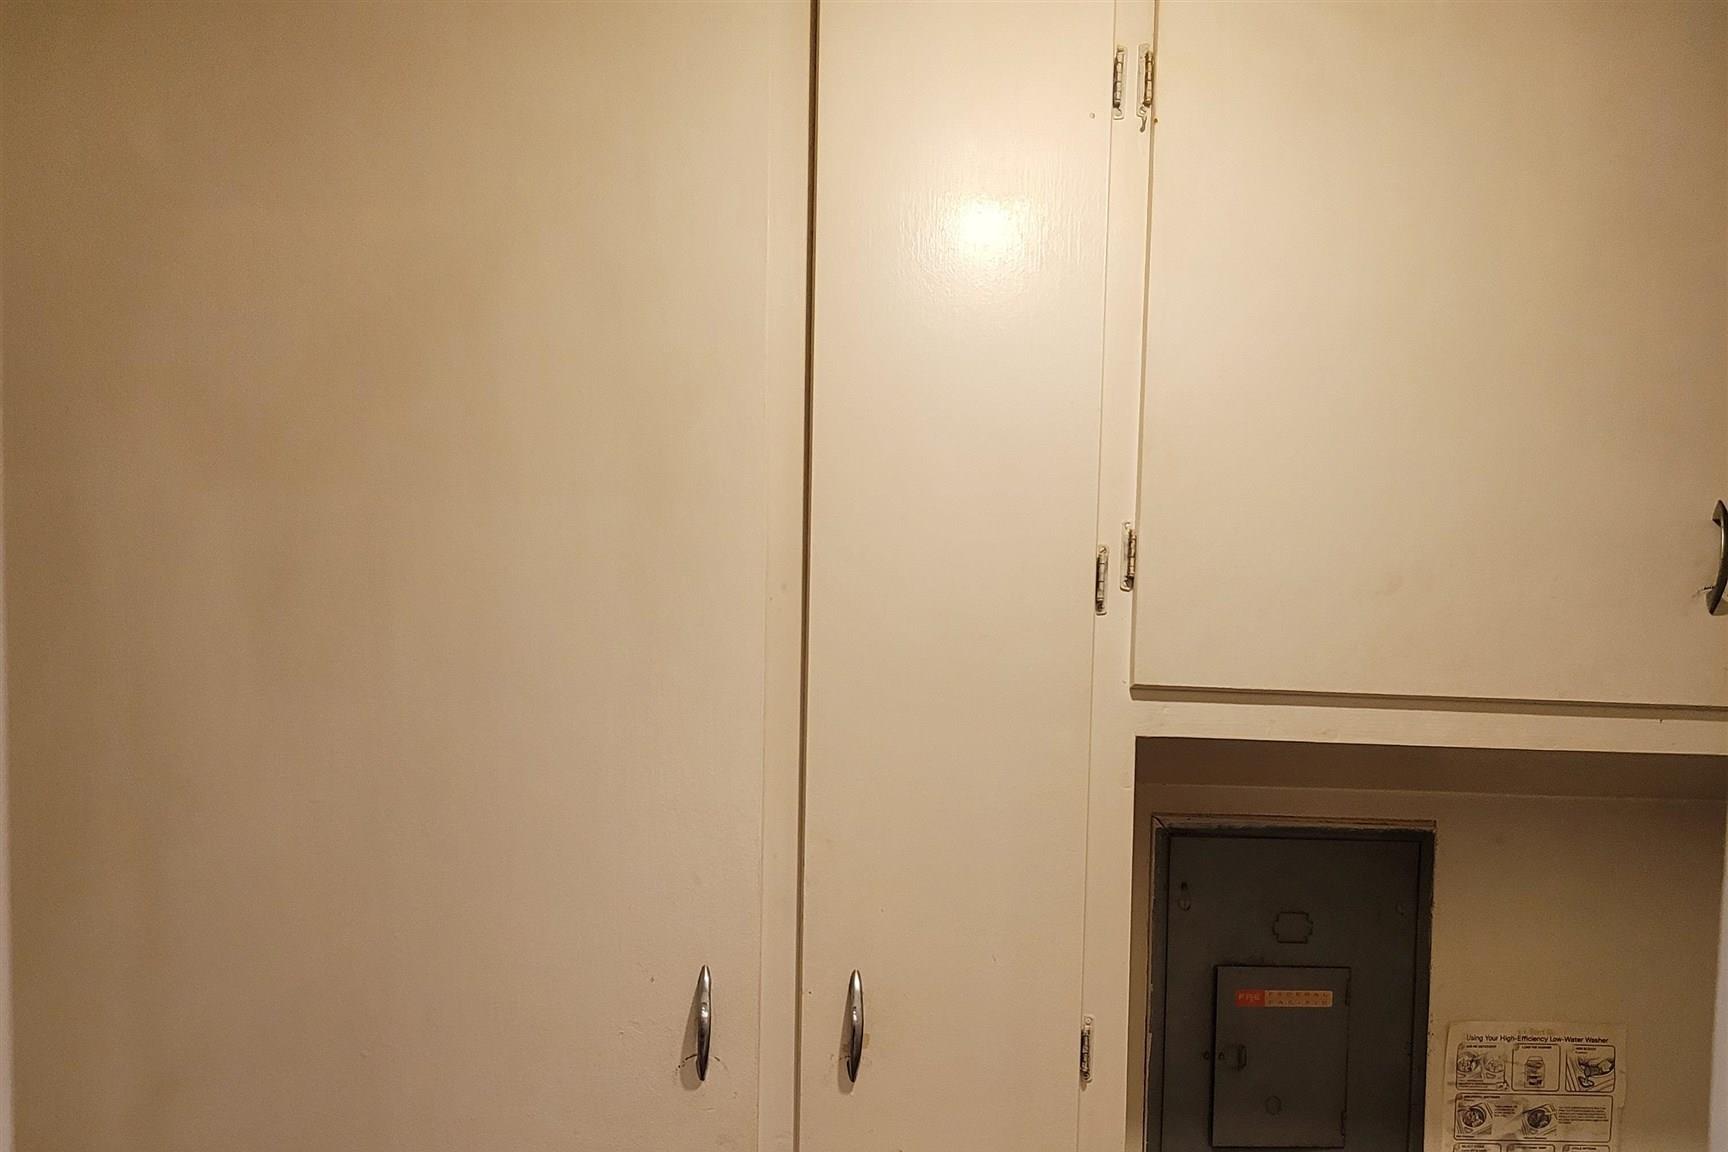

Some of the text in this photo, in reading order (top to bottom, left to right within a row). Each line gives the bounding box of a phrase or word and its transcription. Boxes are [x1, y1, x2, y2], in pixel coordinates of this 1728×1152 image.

[1466, 1034, 1484, 1042] Using
[1500, 1034, 1549, 1043] High-Efficiency
[1549, 1035, 1584, 1043] Low-Water
